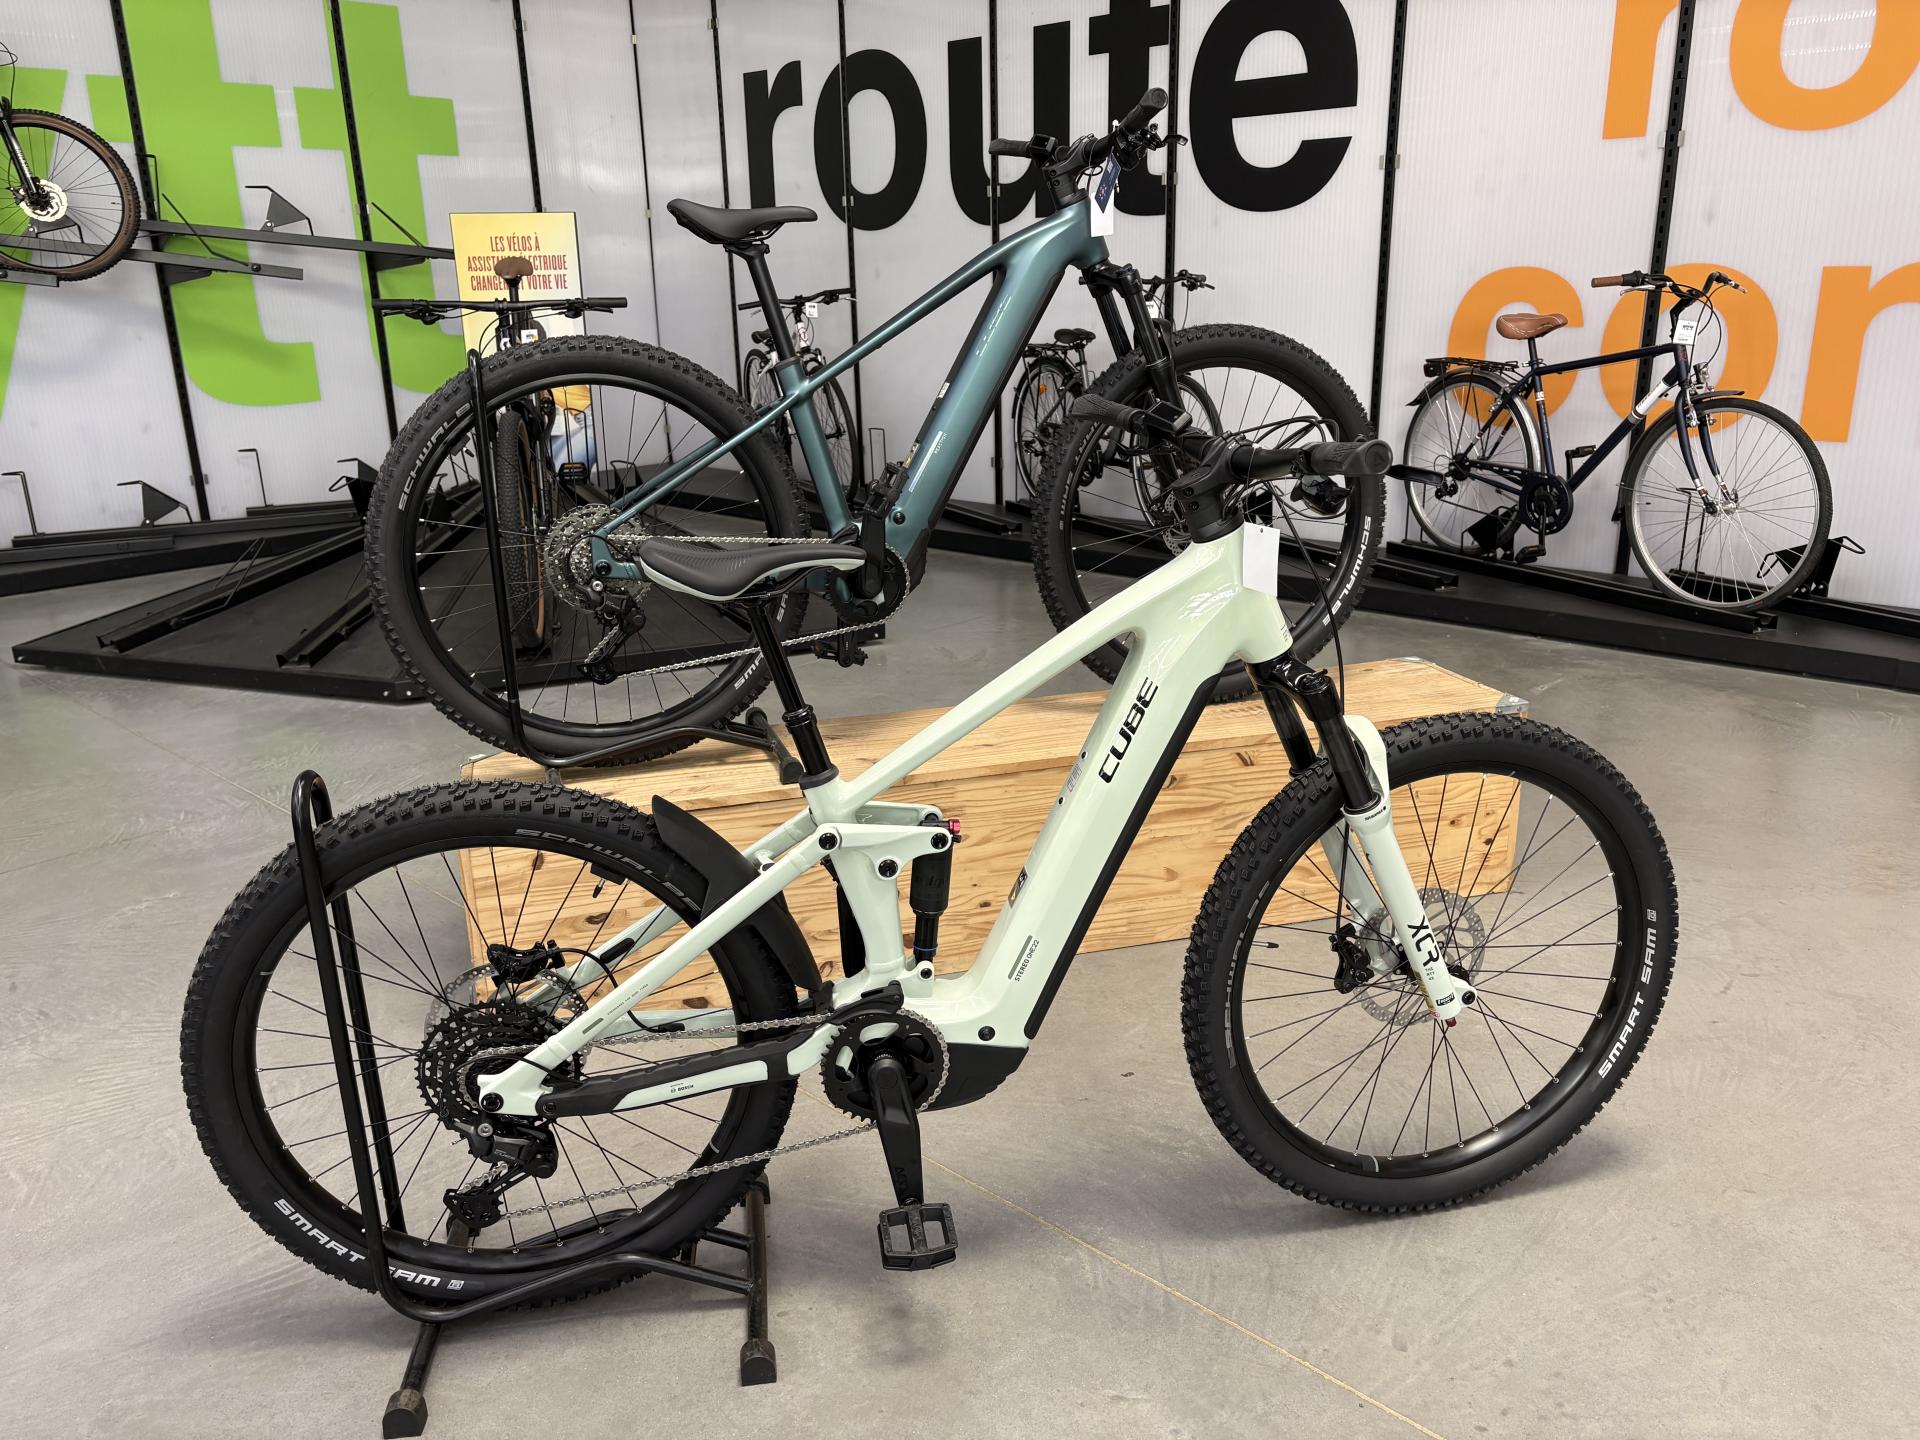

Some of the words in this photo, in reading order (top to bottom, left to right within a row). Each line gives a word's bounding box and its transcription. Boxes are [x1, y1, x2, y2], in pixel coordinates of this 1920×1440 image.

[743, 0, 1359, 231] route
[490, 236, 504, 252] LES
[507, 232, 532, 252] VÉLOS
[534, 232, 541, 251] À
[527, 274, 552, 290] VOTRE
[555, 273, 568, 290] VIE
[398, 401, 474, 511] SCHWALB
[1322, 515, 1372, 626] SCHWALBE
[734, 653, 764, 690] SMA
[776, 593, 789, 623] SA
[1097, 676, 1158, 784] CUBE
[514, 828, 702, 912] SCHWALBE
[1014, 957, 1030, 982] STEREO
[1598, 991, 1645, 1079] SMART
[1640, 927, 1657, 985] SAM
[273, 1198, 367, 1263] SMART
